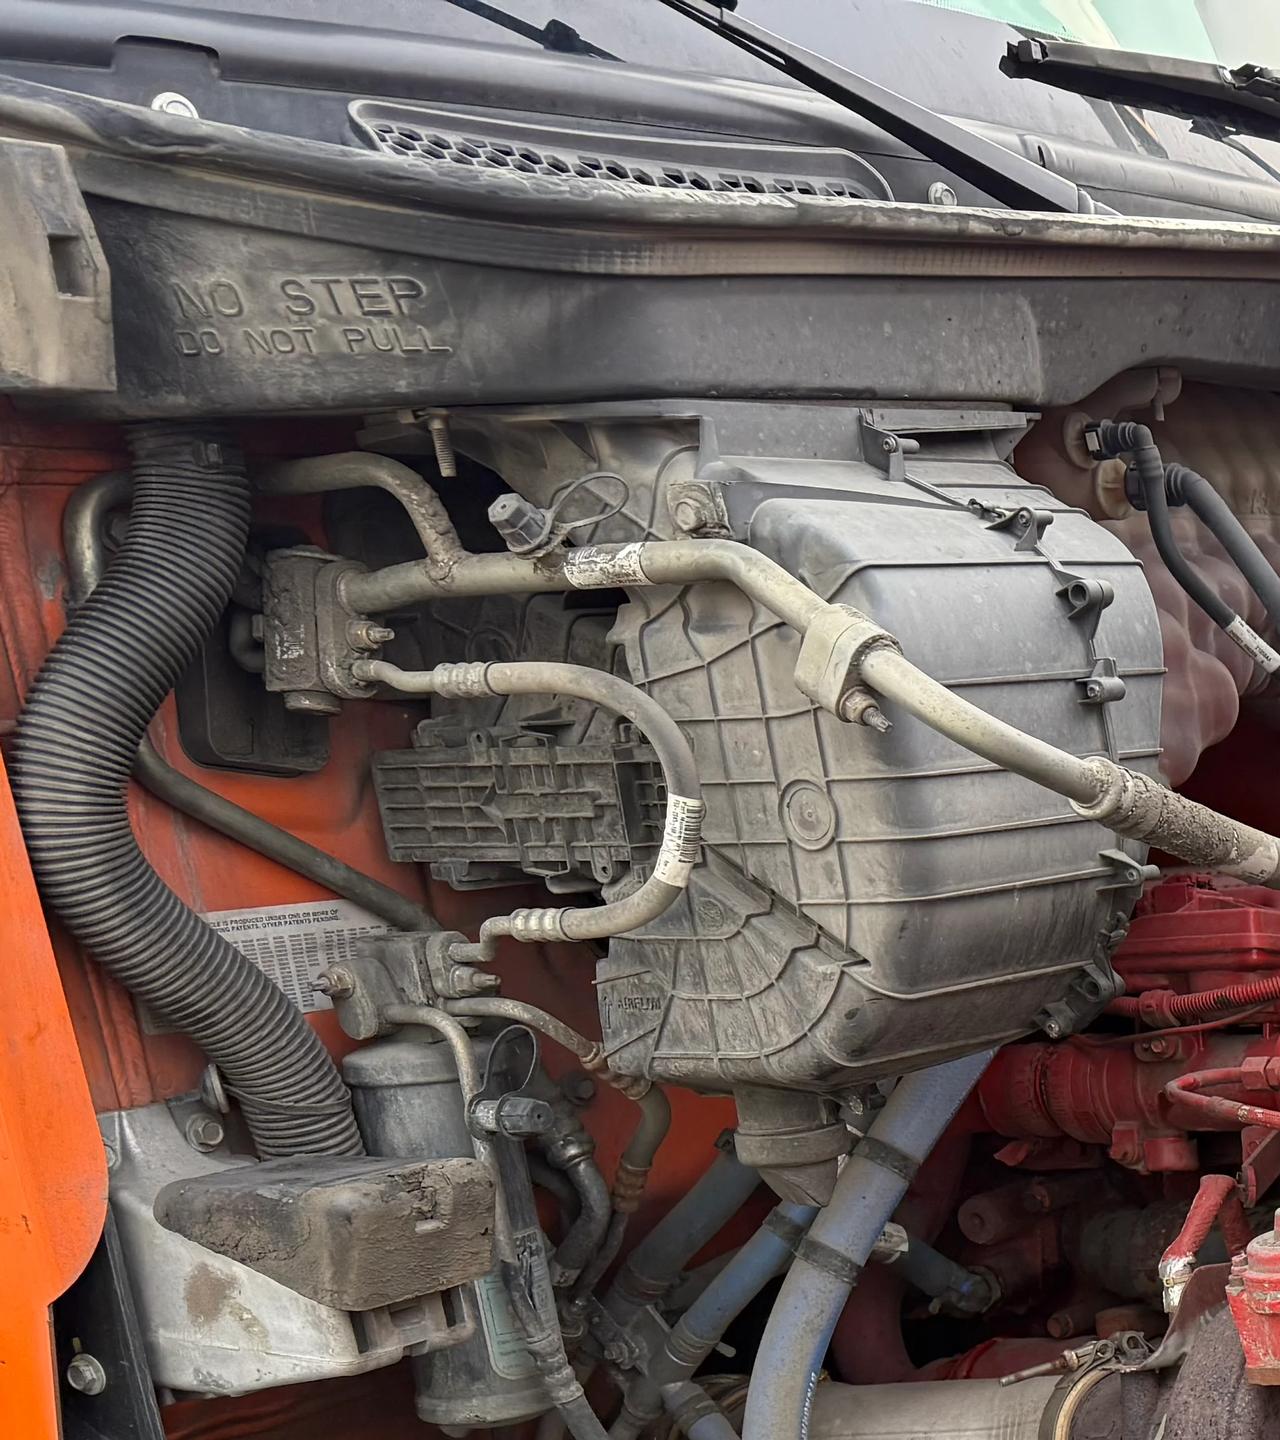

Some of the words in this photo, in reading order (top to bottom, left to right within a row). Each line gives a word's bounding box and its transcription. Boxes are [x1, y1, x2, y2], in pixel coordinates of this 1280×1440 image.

[172, 279, 243, 318] NO
[280, 276, 425, 317] STEP
[176, 329, 221, 356] DO
[244, 327, 314, 355] NOT
[343, 325, 453, 357] PULL
